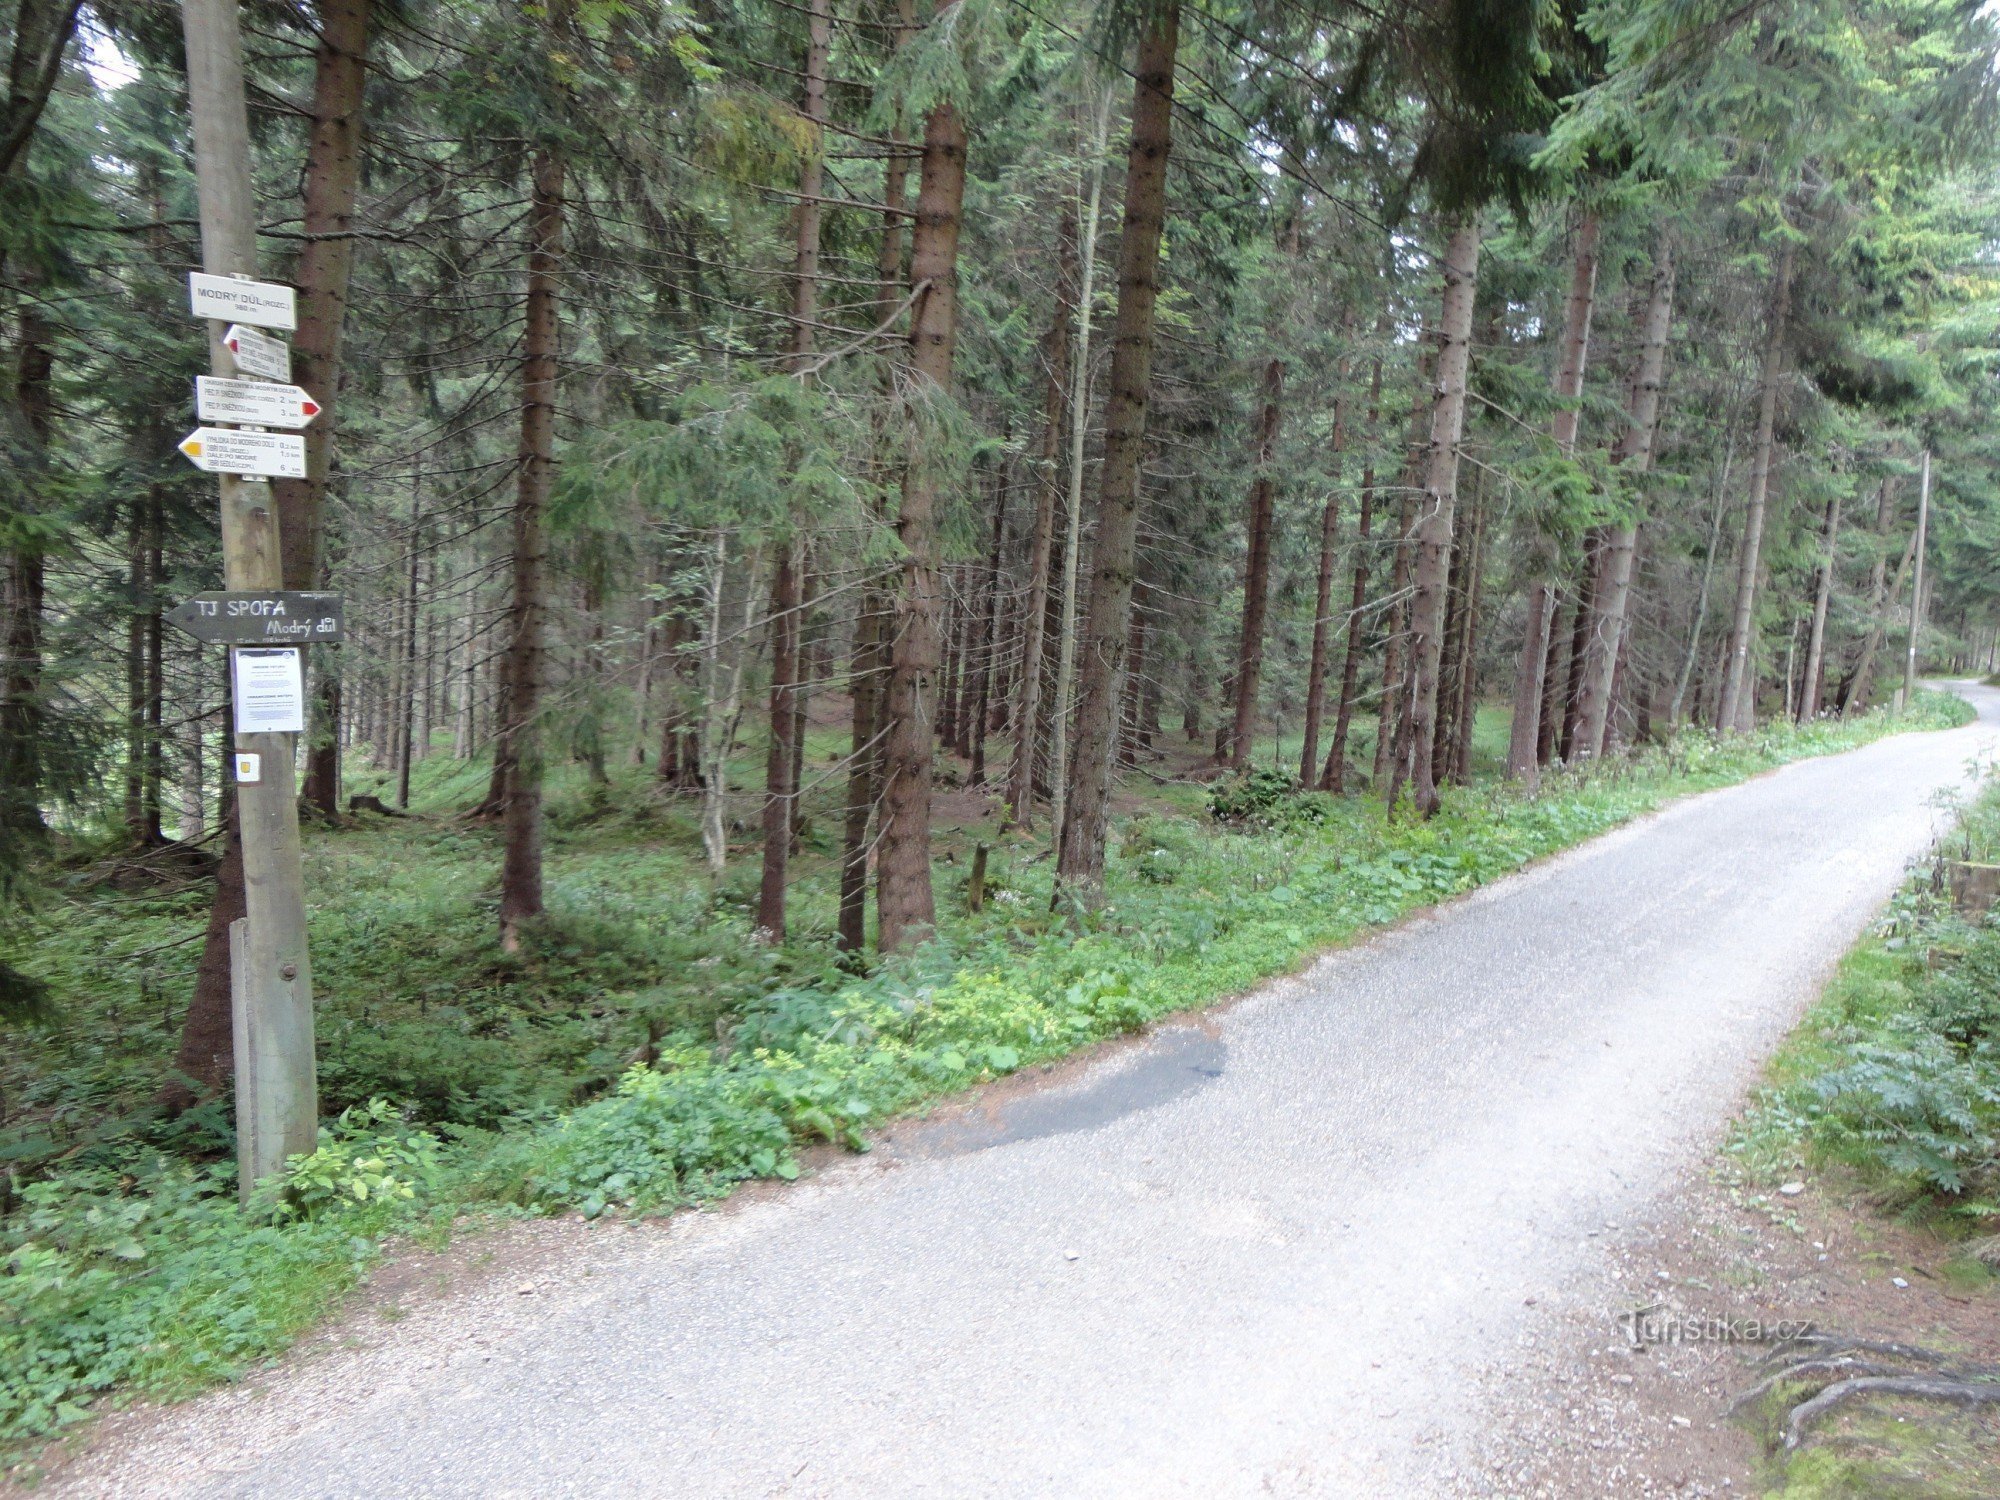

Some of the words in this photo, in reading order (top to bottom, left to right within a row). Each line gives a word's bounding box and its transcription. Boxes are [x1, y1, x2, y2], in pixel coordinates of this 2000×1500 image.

[197, 287, 237, 301] MODRÝ
[241, 293, 263, 306] DŮL
[279, 396, 285, 404] 2
[195, 600, 218, 616] TJ
[227, 600, 286, 616] SPOFA
[266, 618, 311, 637] Modrý
[316, 617, 336, 633] důl
